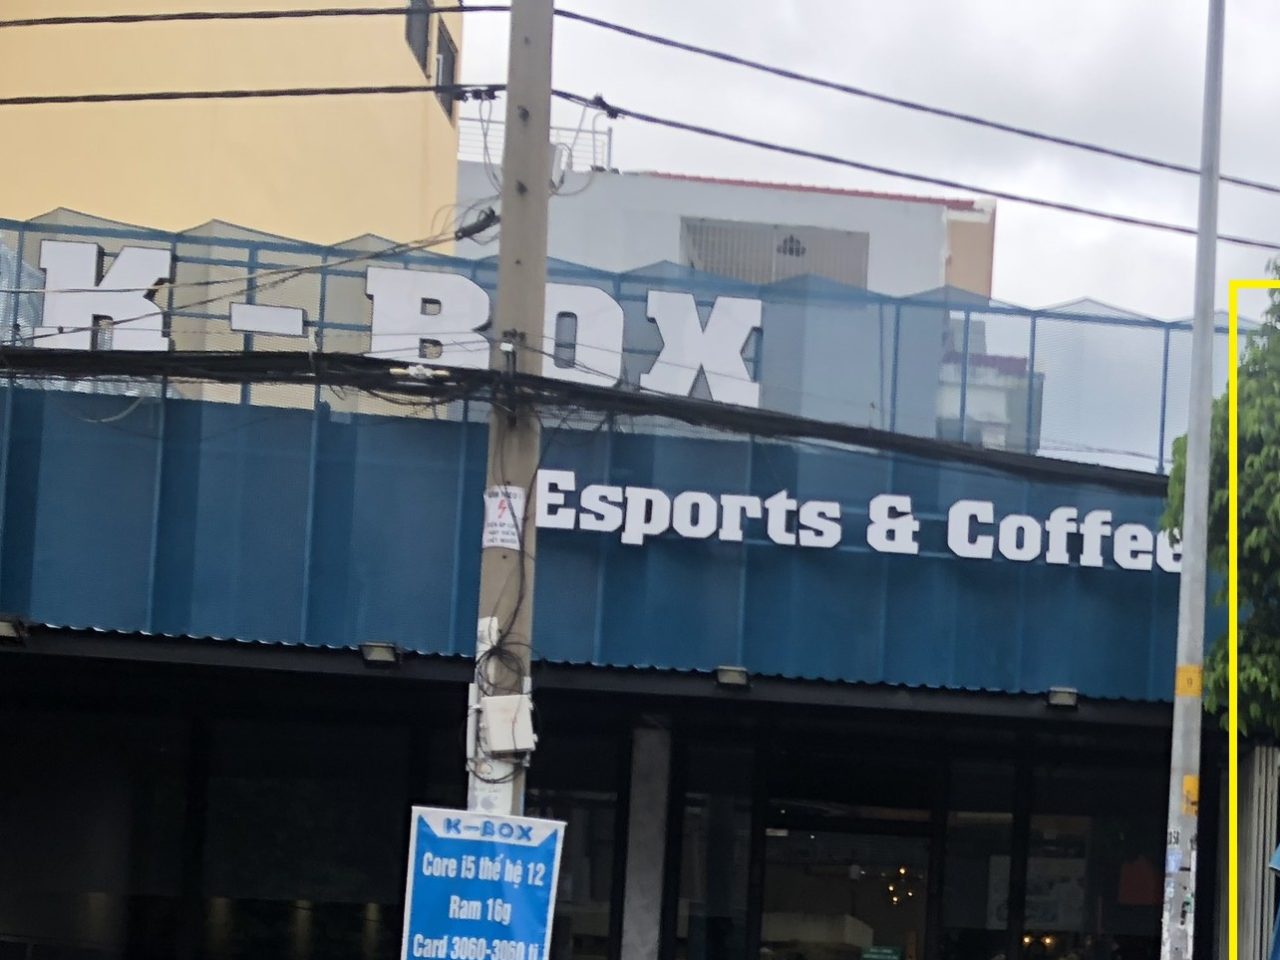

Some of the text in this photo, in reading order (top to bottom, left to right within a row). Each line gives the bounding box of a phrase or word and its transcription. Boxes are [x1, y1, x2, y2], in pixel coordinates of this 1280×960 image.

[536, 469, 842, 548] Esports
[866, 493, 919, 554] &
[444, 817, 533, 842] K-BOX
[422, 851, 546, 889] Core i5 thế hệ 12
[448, 894, 512, 926] Ram 16g
[413, 933, 449, 959] Card
